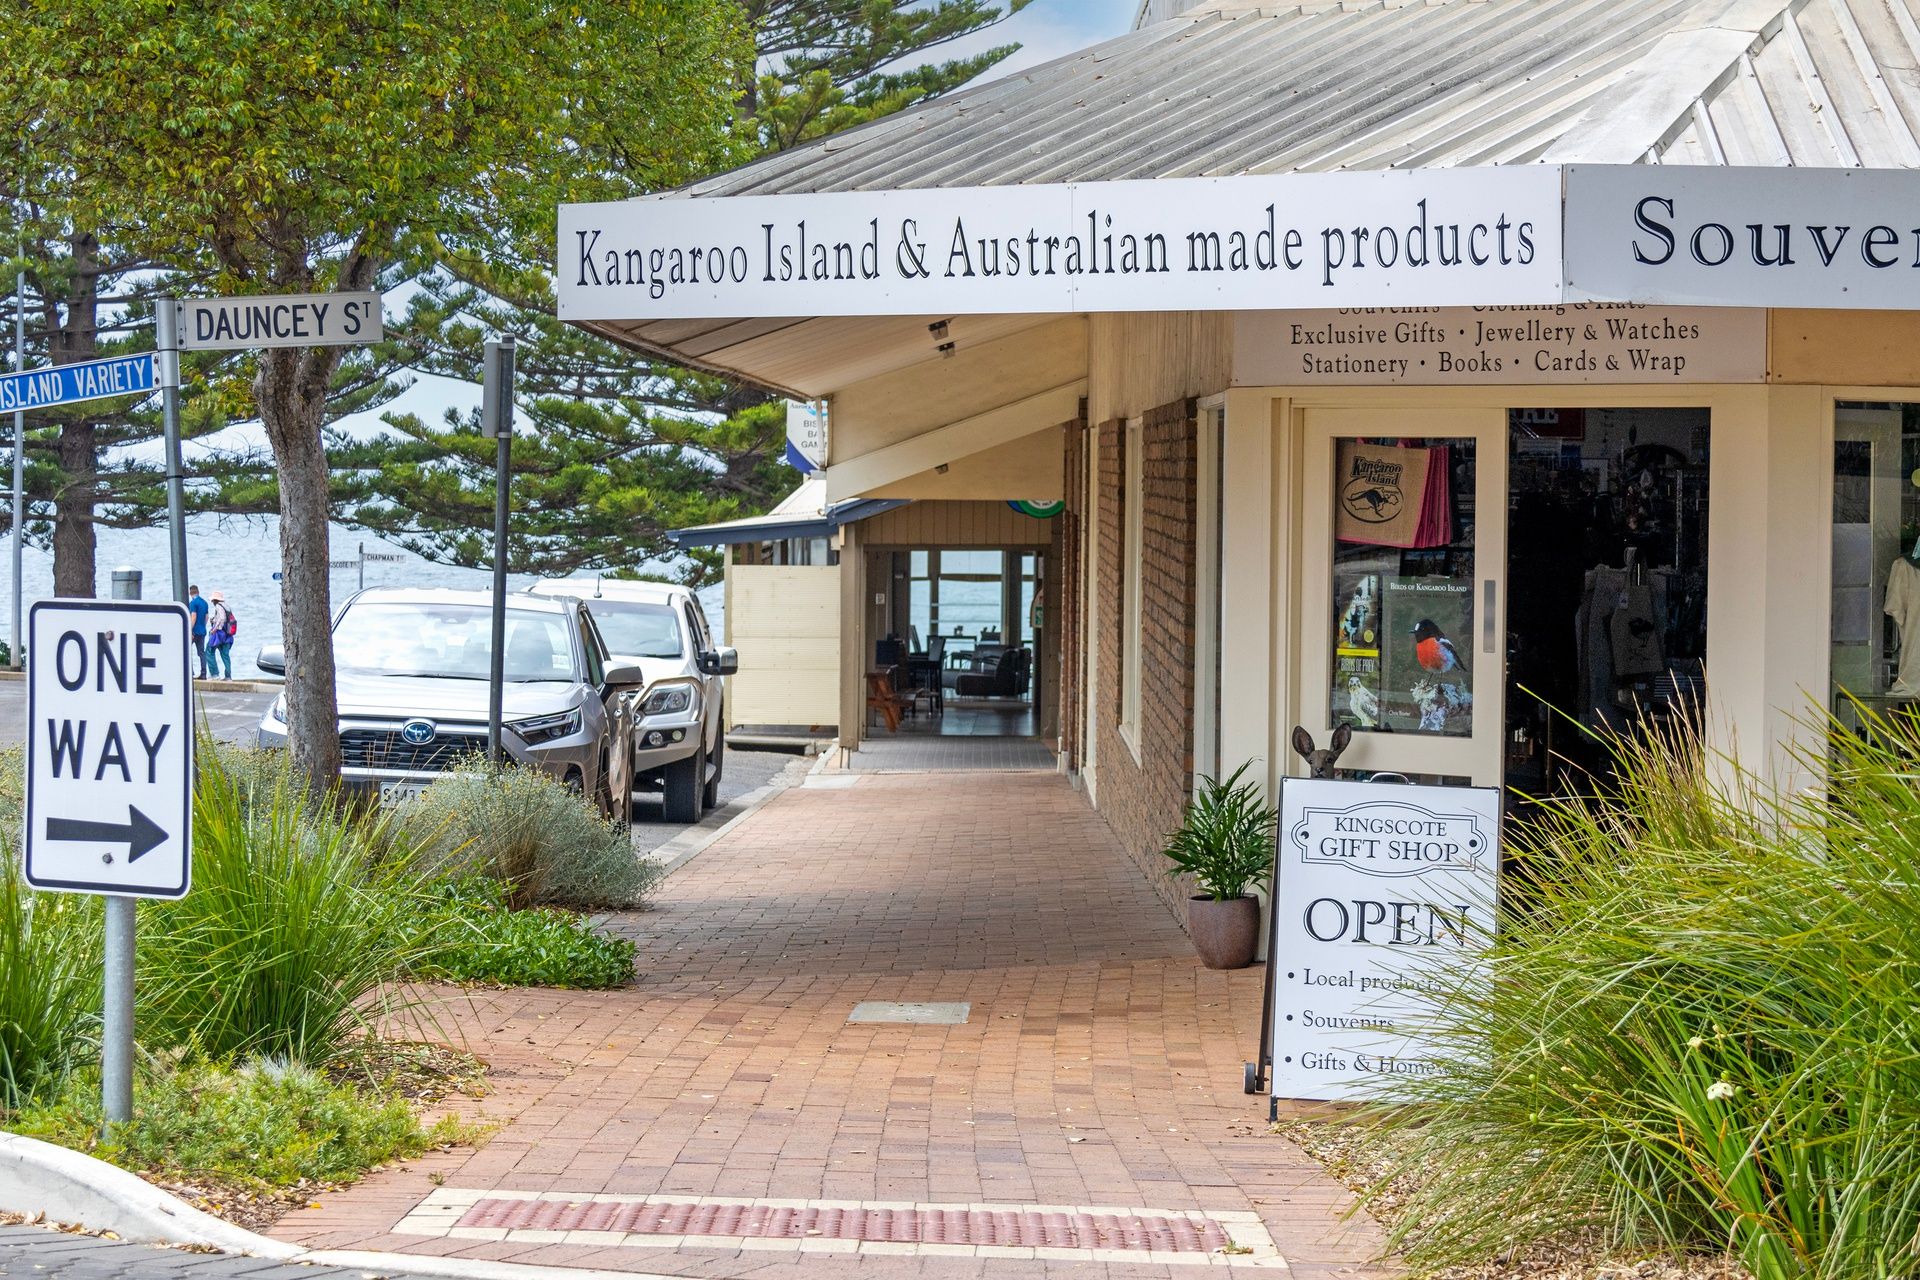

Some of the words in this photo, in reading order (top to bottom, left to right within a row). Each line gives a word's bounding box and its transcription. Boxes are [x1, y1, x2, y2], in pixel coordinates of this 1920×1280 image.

[1632, 196, 1920, 268] Souve
[575, 229, 748, 299] Kangaroo
[761, 217, 880, 282] Island
[895, 218, 930, 279] &
[944, 209, 1170, 277] Australian
[1185, 203, 1303, 272] made
[1321, 197, 1535, 286] products
[196, 303, 330, 342] DAUNCEY
[1290, 323, 1387, 345] Exclusive
[1395, 321, 1446, 343] Gifts
[1475, 319, 1576, 346] Jewellery
[1583, 324, 1598, 341] &
[1605, 317, 1699, 340] Watches
[1303, 352, 1409, 377] Stationery
[1438, 350, 1502, 372] Books
[1535, 349, 1597, 371] Cards
[1605, 354, 1620, 371] &
[1627, 349, 1686, 375] Wrap
[0, 372, 63, 409] ISLAND
[74, 357, 147, 397] VARIETY
[1352, 456, 1403, 476] Kangaroo
[1366, 471, 1400, 486] Island
[367, 553, 394, 561] CHAPMAN
[1390, 582, 1407, 591] BIRDS
[1416, 583, 1447, 592] KANGAROO
[1448, 584, 1467, 592] ISLAND
[56, 630, 163, 694] ONE
[48, 718, 171, 784] WAY
[1334, 816, 1447, 837] KINGSCOTE
[1320, 837, 1381, 859] GIFT
[1388, 840, 1459, 862] SHOP
[1303, 897, 1471, 947] OPEN
[1303, 968, 1354, 988] Local
[1302, 1009, 1395, 1029] Souvenirs
[1301, 1051, 1347, 1072] Gifts
[1353, 1055, 1372, 1072] &
